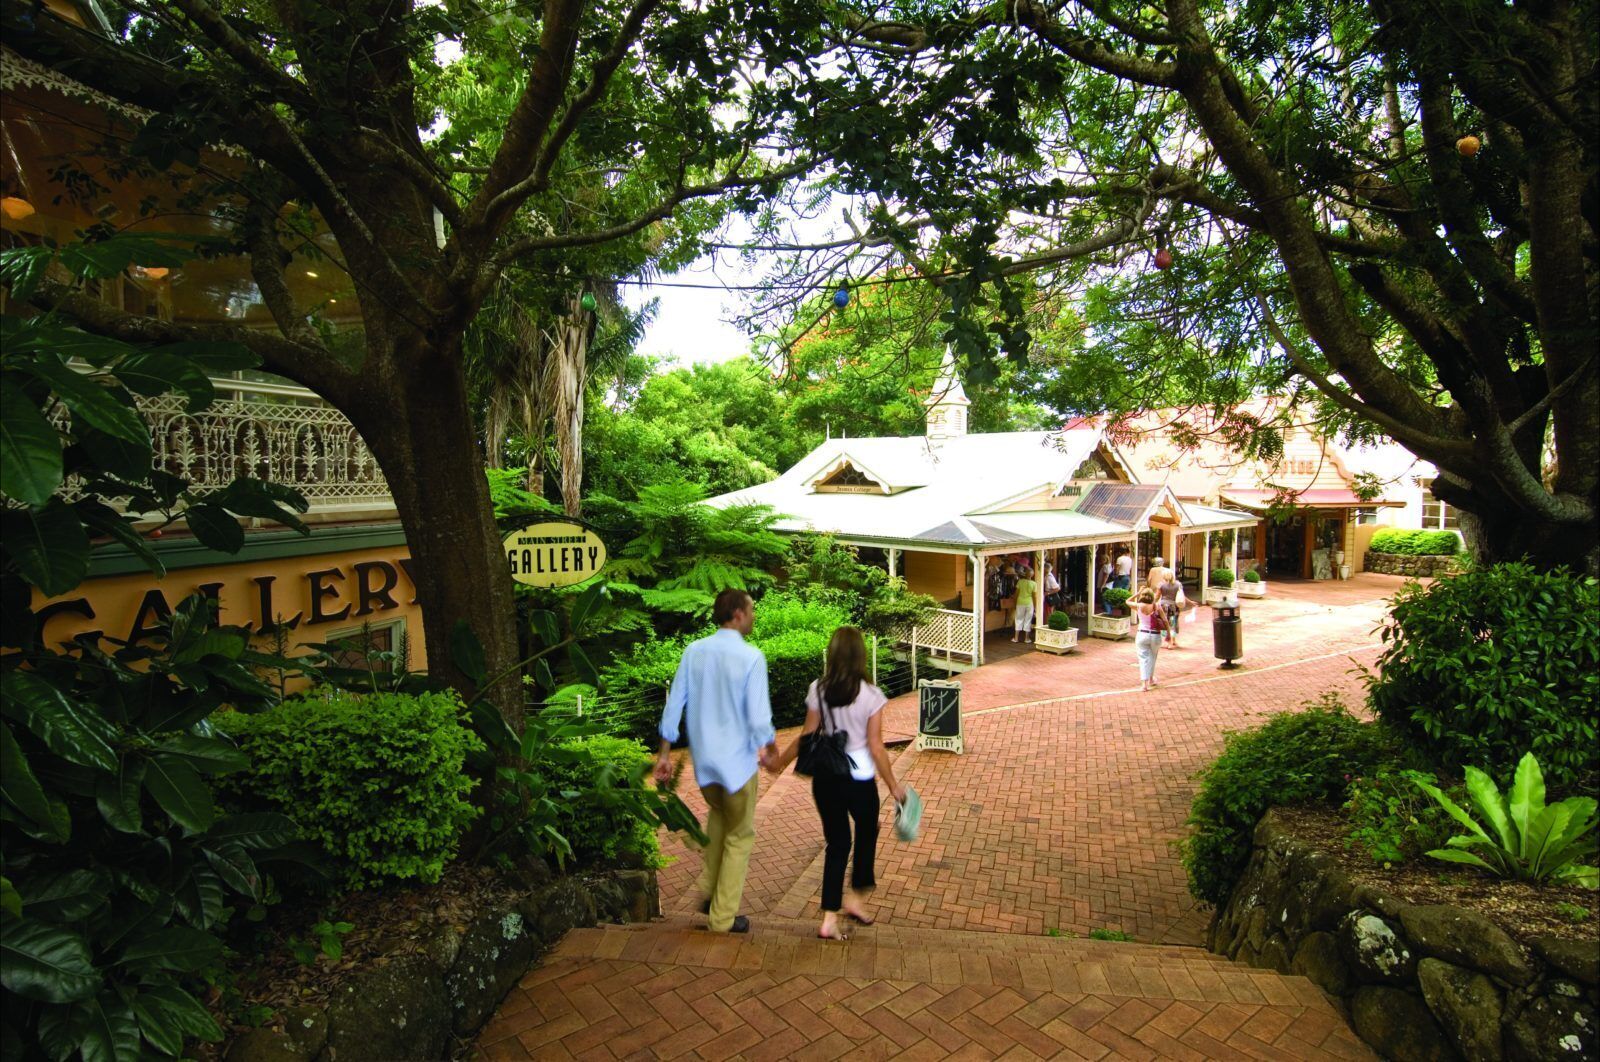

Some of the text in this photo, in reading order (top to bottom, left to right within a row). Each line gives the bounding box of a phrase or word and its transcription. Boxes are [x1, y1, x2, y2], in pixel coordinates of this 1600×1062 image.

[550, 536, 585, 544] STREET
[508, 546, 598, 574] GALLERY
[921, 687, 949, 717] Art
[925, 738, 954, 748] GALLERY
